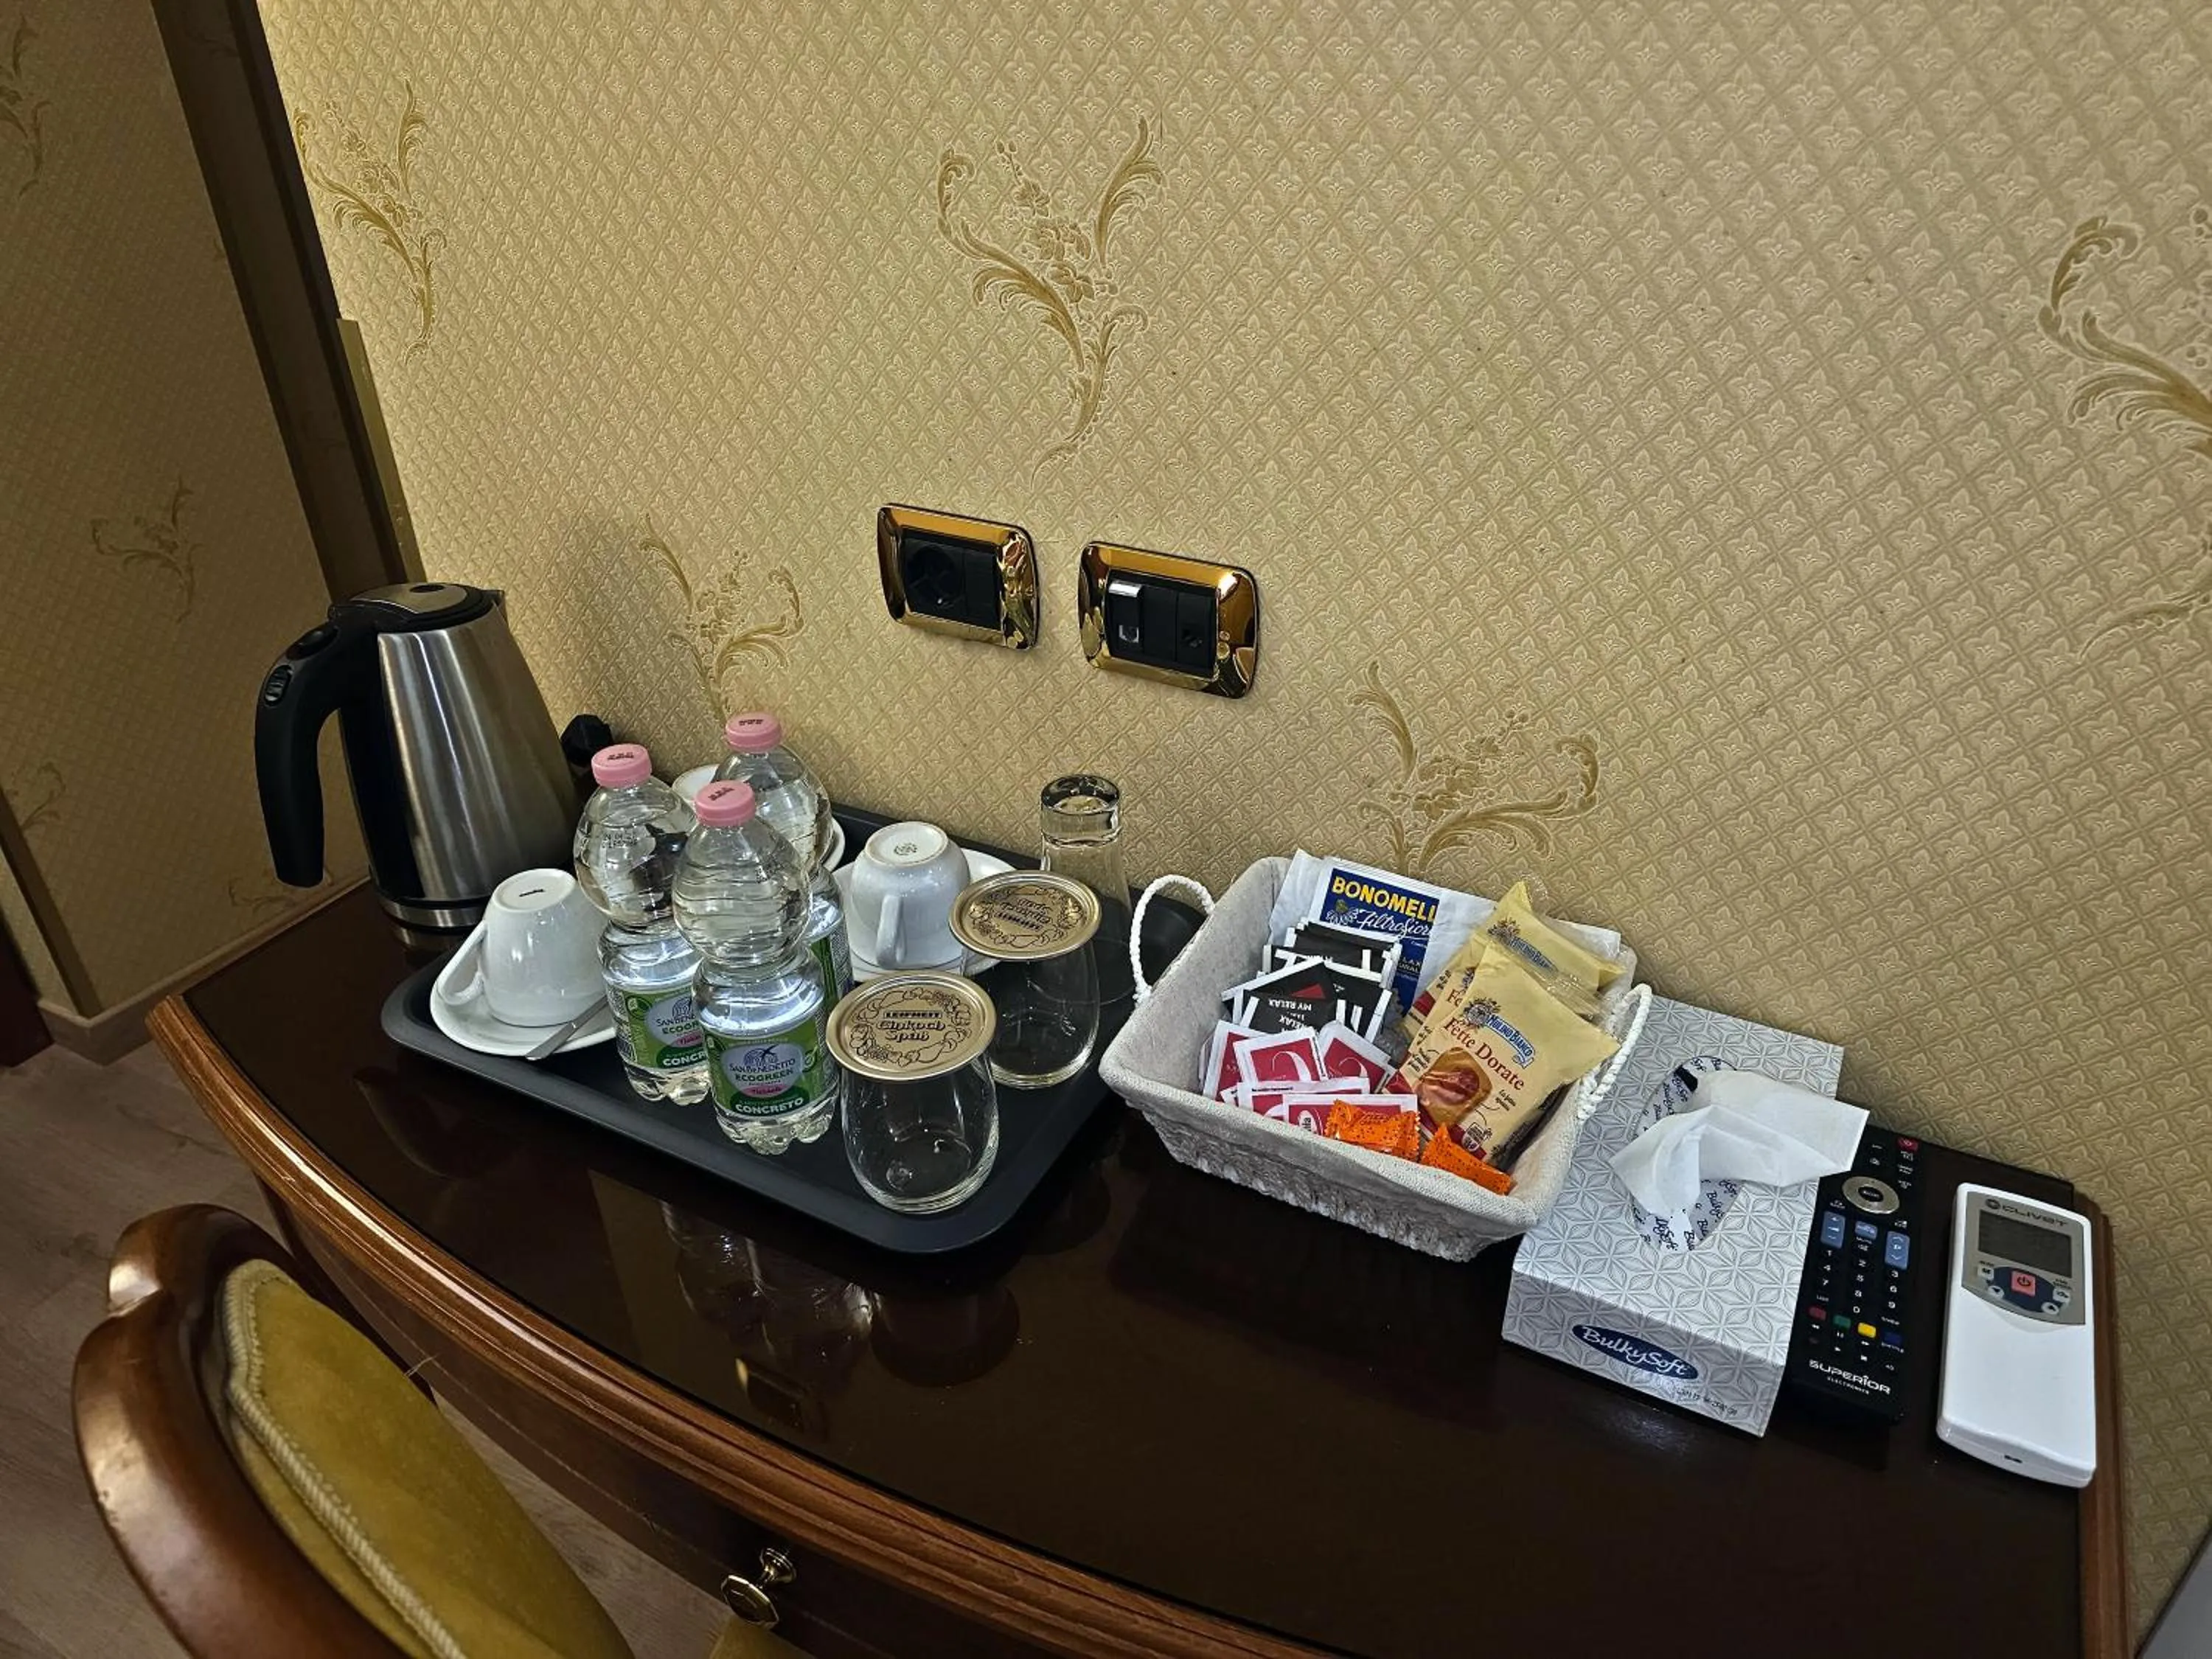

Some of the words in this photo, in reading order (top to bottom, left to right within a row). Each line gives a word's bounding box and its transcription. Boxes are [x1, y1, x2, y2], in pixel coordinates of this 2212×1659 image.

[1268, 998, 1298, 1011] RELAX
[1296, 1001, 1312, 1012] MY
[1444, 1018, 1475, 1048] Fette
[1475, 1042, 1525, 1091] Dorate
[734, 1068, 794, 1082] ECOGREEN
[735, 1097, 804, 1115] CONCRETO
[2001, 1205, 2068, 1227] CLIVET
[1583, 1326, 1689, 1375] BulkySoft
[1809, 1359, 1892, 1396] SUPERIOR
